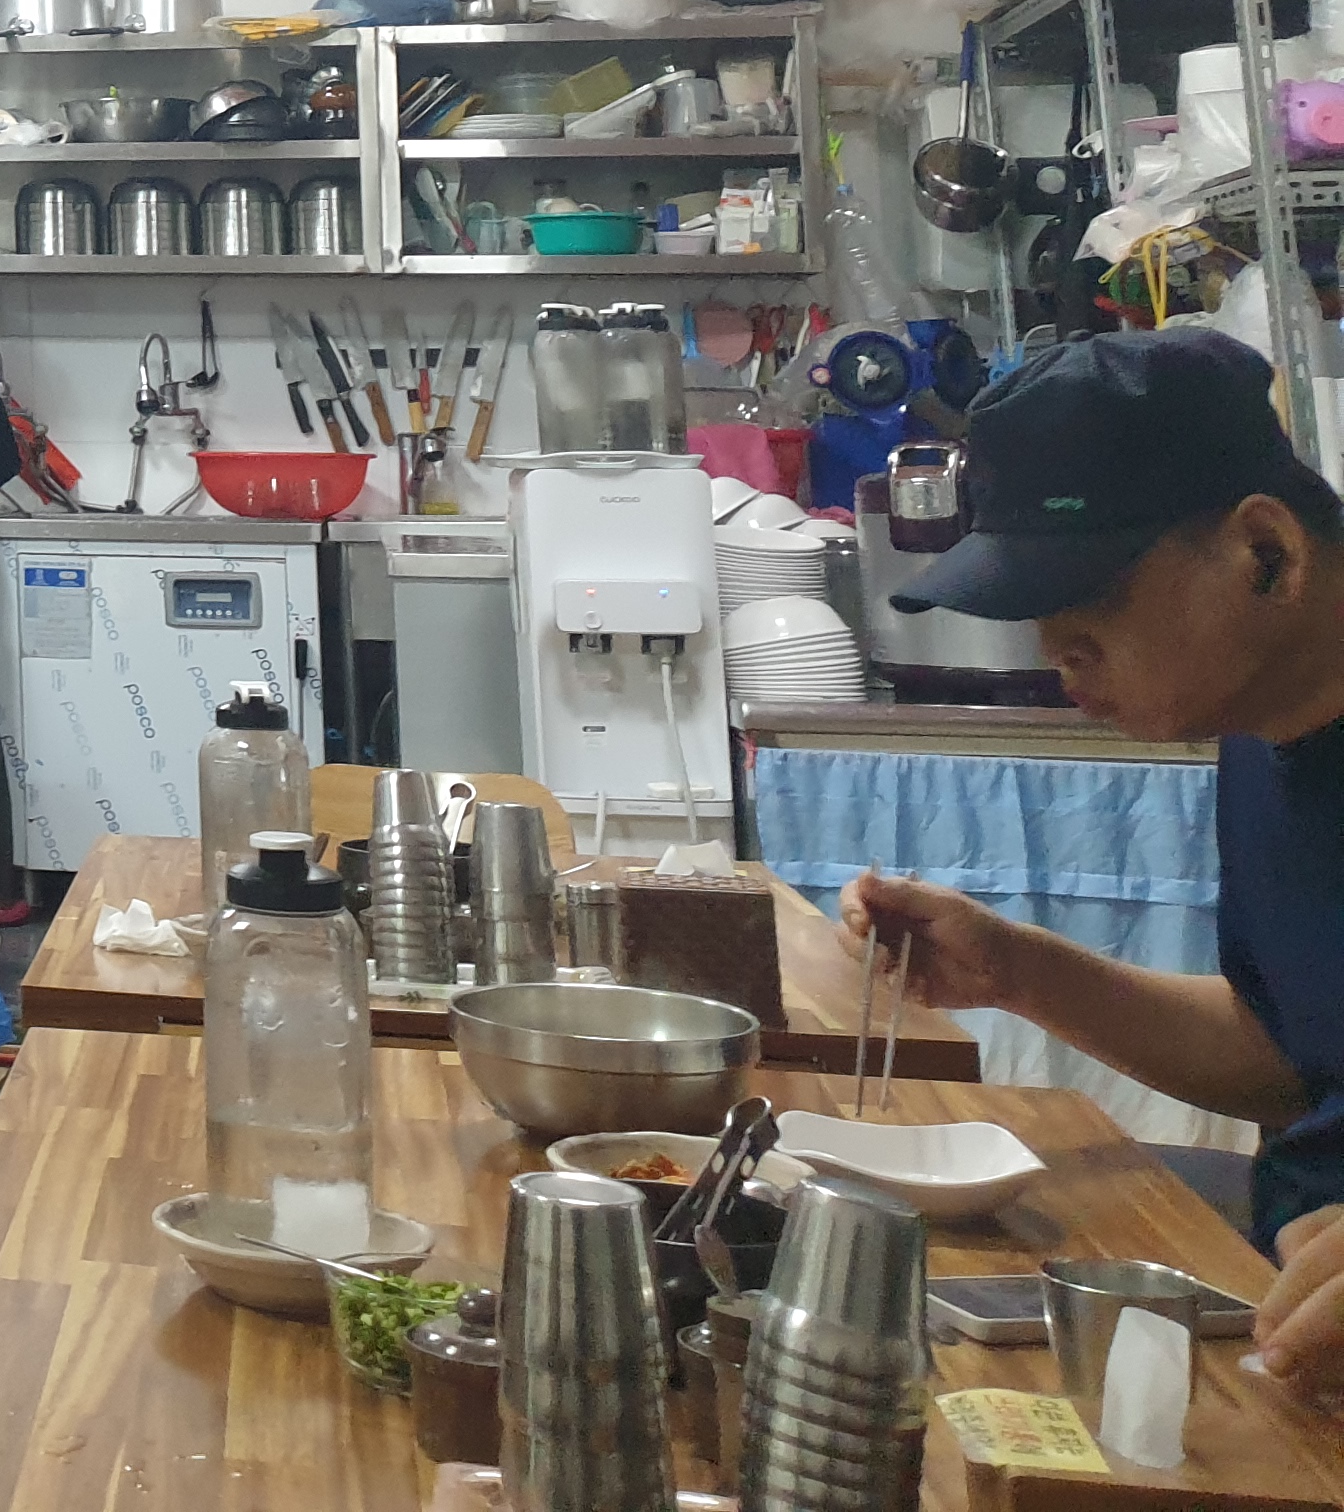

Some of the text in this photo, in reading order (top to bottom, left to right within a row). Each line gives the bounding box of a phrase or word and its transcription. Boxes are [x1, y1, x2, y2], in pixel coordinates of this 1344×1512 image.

[251, 649, 285, 704] posco
[123, 683, 156, 739] posco
[95, 799, 121, 835] pos
[160, 782, 191, 838] posco
